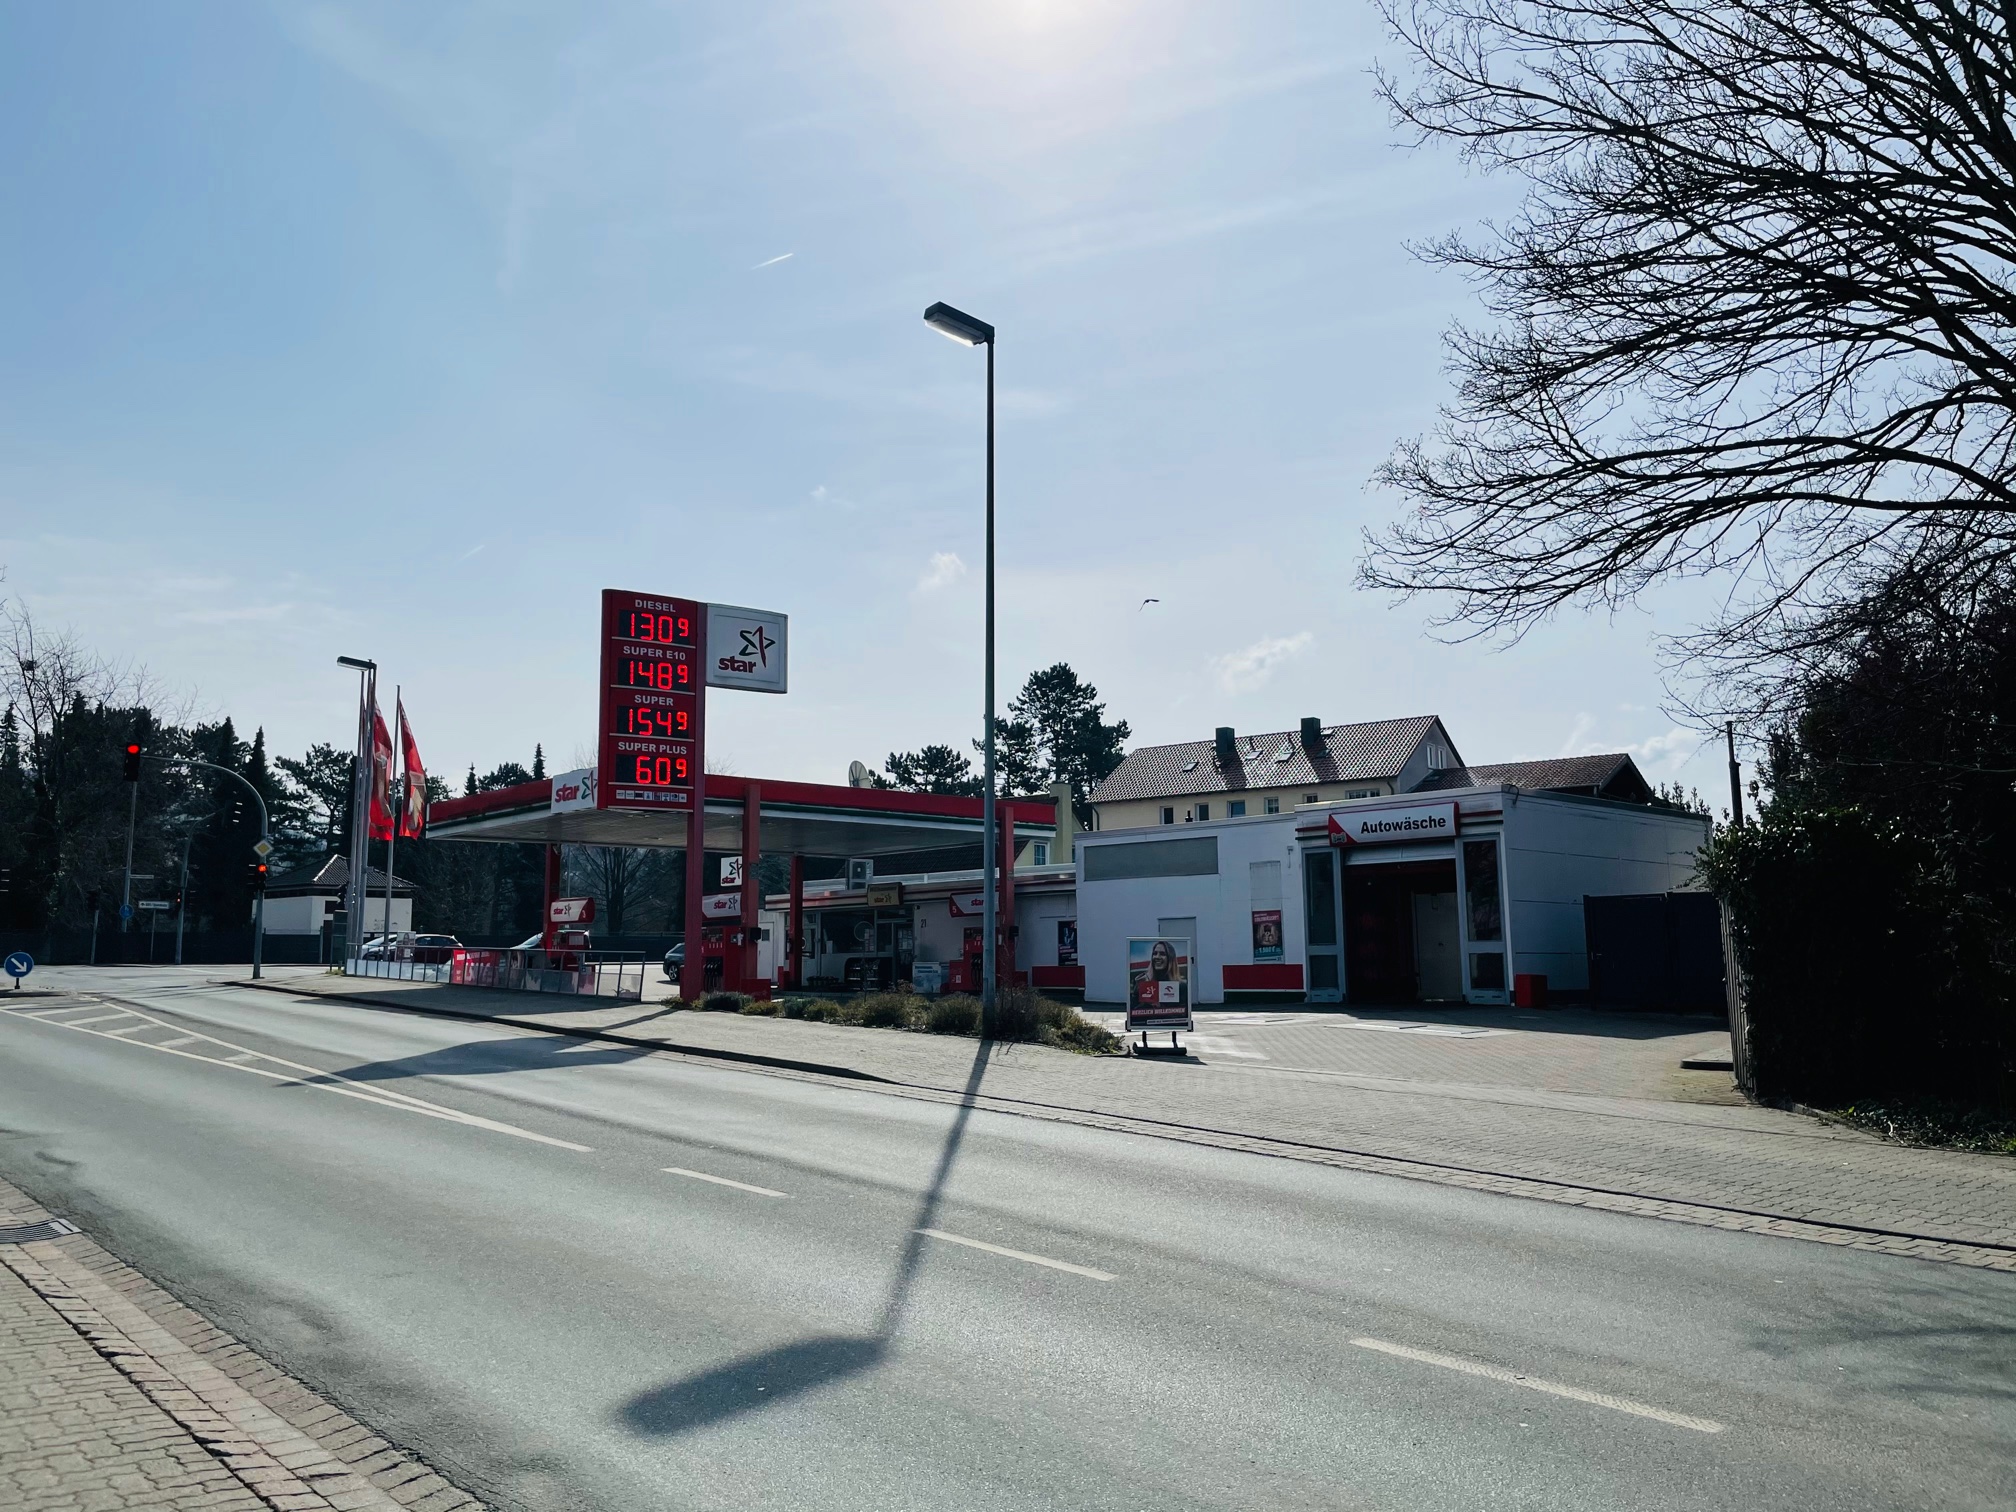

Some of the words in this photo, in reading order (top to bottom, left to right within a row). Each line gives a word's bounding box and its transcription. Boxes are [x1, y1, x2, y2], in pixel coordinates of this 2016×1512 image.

[635, 599, 676, 613] DIESEL
[623, 645, 663, 658] SUPER
[666, 649, 686, 661] E10
[718, 655, 757, 674] star
[634, 694, 674, 706] SUPER
[618, 741, 657, 754] SUPER
[659, 743, 687, 755] PLUS
[555, 784, 580, 803] star
[1360, 815, 1446, 834] Autowäsche
[721, 876, 737, 885] star
[553, 907, 564, 915] star
[713, 899, 728, 910] star
[952, 906, 957, 914] 5
[920, 918, 927, 928] 21
